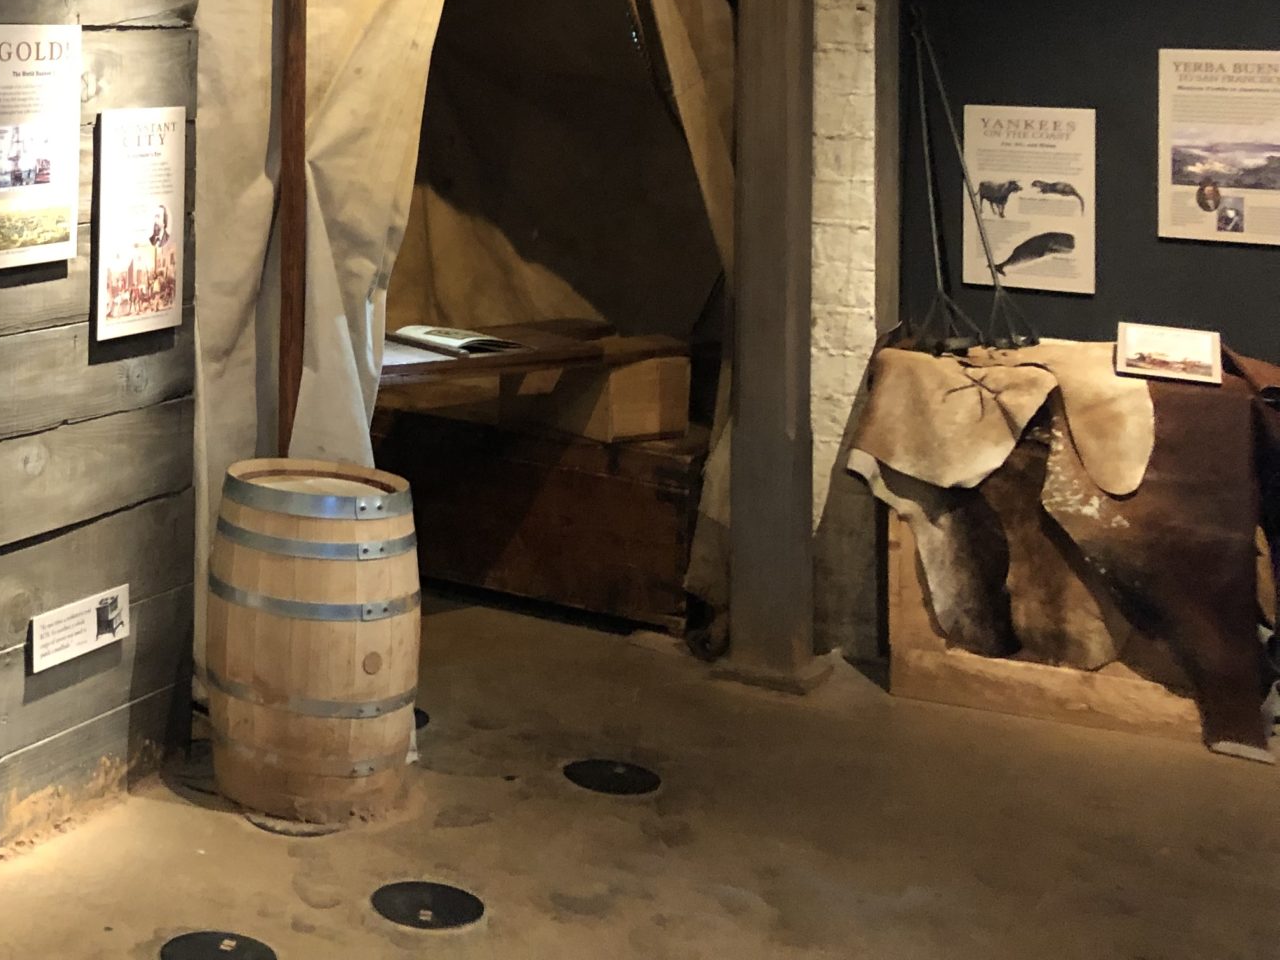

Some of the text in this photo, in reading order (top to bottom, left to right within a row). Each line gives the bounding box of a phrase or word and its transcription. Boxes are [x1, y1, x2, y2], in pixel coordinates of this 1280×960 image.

[1172, 62, 1225, 72] YERBA
[980, 118, 1076, 131] YANKEES
[1006, 130, 1026, 138] THE
